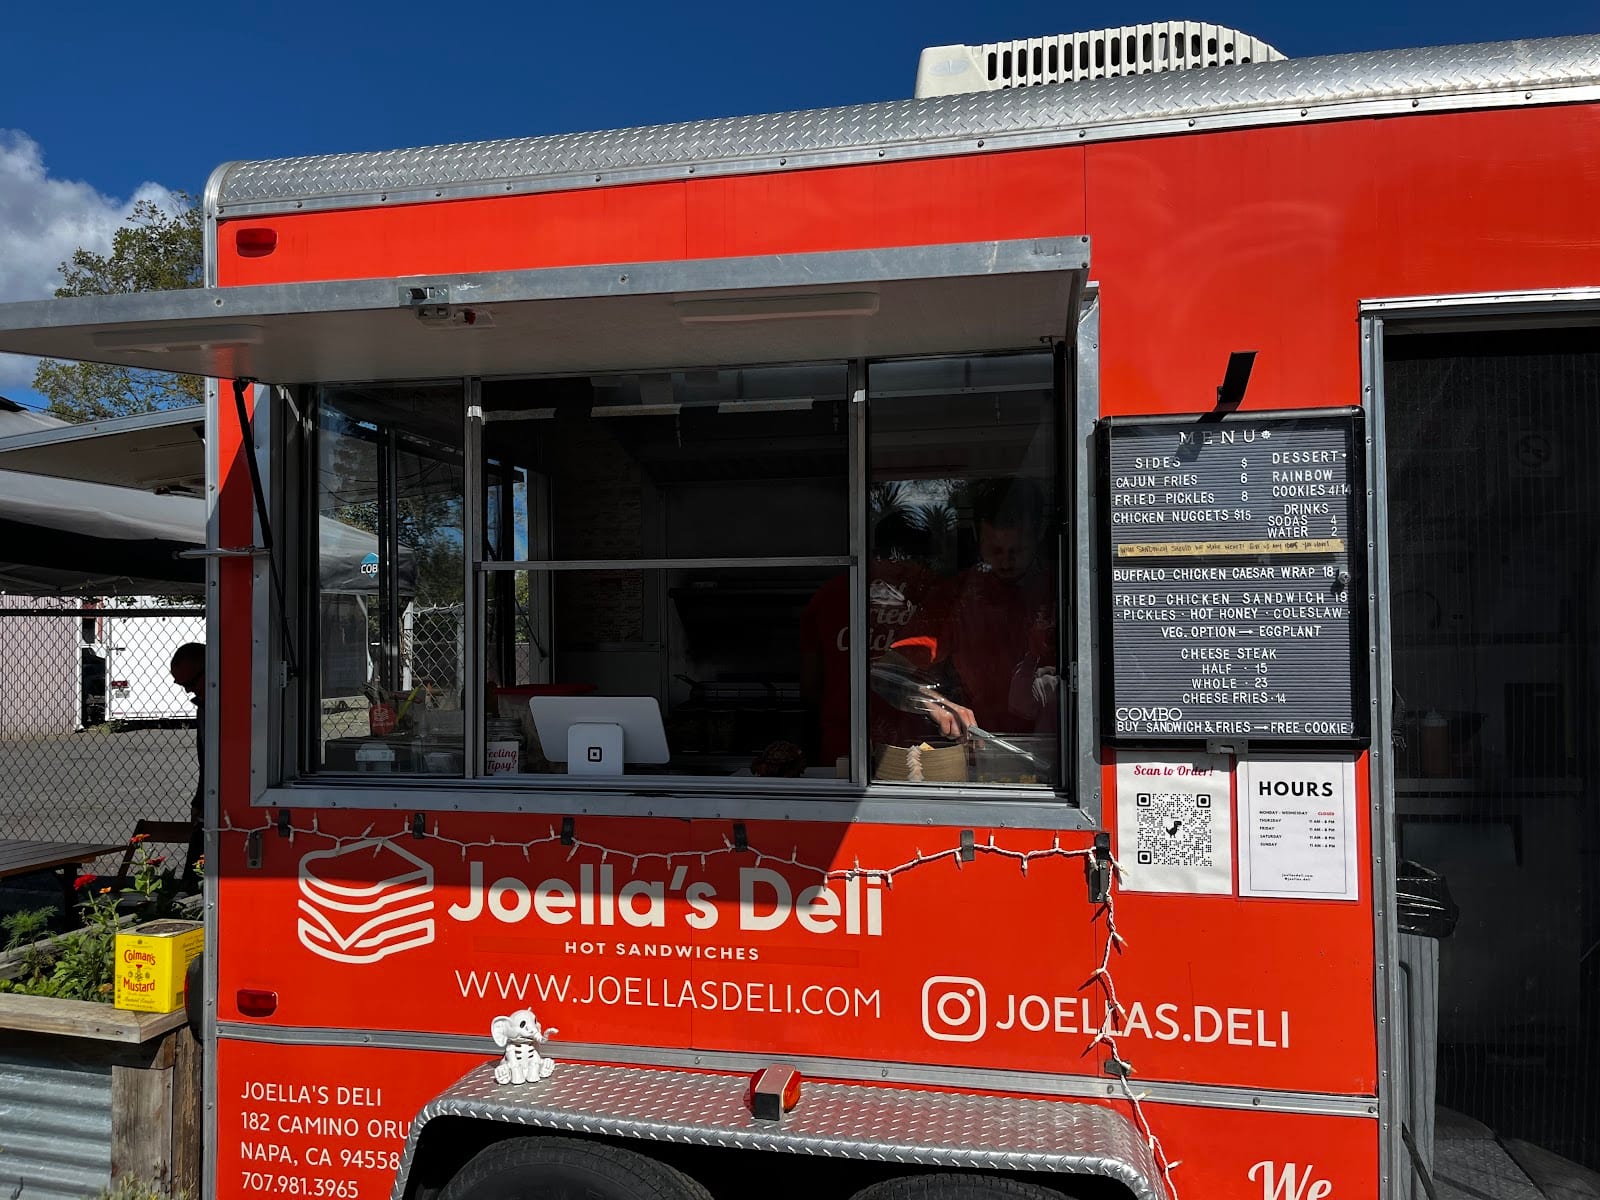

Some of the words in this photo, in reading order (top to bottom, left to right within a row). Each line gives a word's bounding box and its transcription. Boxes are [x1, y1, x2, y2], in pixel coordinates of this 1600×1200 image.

[1179, 430, 1255, 445] MENU
[1135, 457, 1181, 469] SIDES
[1241, 457, 1248, 469] $
[1273, 451, 1338, 464] DESSERT
[1116, 477, 1155, 489] CAJUN
[1164, 475, 1198, 485] FRIES
[1241, 473, 1247, 484] 6
[1273, 469, 1333, 482] RAINBOW
[1273, 484, 1325, 497] COOKIES
[1115, 493, 1155, 506] FRIED
[1166, 492, 1214, 503] PICKLES
[1241, 491, 1248, 502] 8
[1113, 511, 1164, 523] CHICKEN
[1172, 510, 1228, 522] NUGGETS
[1234, 509, 1251, 520] $15
[1284, 503, 1328, 515] DRINKS
[1267, 515, 1307, 526] SODAS
[1330, 515, 1337, 525] 4
[1267, 526, 1308, 538] WATER
[1331, 527, 1337, 537] 2
[1113, 569, 1165, 581] BUFFALO
[1173, 568, 1226, 580] CHICKEN
[1232, 567, 1274, 579] CAESAR
[1281, 567, 1315, 578] WRAP
[1323, 566, 1334, 577] 18
[1115, 595, 1155, 606] FRIED
[1167, 594, 1229, 605] CHICKEN
[1242, 592, 1324, 604] SANDWICH
[1123, 609, 1175, 620] PICKLES
[1190, 609, 1213, 619] HOT
[1219, 608, 1257, 619] HONEY
[1274, 607, 1342, 619] COLESLAW
[1161, 627, 1188, 638] VEG.
[1191, 626, 1236, 637] OPTION
[1259, 625, 1321, 636] EGGPLANT
[1181, 648, 1229, 660] CHEESE
[1237, 648, 1277, 659] STEAK
[1202, 664, 1231, 675] HALF
[1255, 663, 1267, 674] 15
[1191, 678, 1237, 689] WHOLE
[1254, 678, 1267, 688] 23
[1182, 692, 1228, 704] CHEESE
[1232, 692, 1268, 704] FRIES
[1276, 692, 1286, 704] 14
[1115, 707, 1182, 721] COMBO
[1117, 722, 1139, 732] BUY
[1146, 721, 1201, 733] SANDWICH
[1205, 722, 1213, 733] &
[1216, 721, 1250, 733] FRIES
[1270, 722, 1299, 733] FREE
[1305, 722, 1353, 734] COOKIE!
[488, 749, 516, 760] eeling
[1134, 765, 1161, 777] Scan
[1162, 765, 1174, 776] to
[1177, 765, 1215, 777] Order!
[1259, 781, 1333, 797] HOURS
[447, 860, 719, 931] Joella’s
[739, 867, 882, 936] Deli
[124, 949, 155, 965] Colman's
[564, 940, 606, 956] HOT
[615, 944, 760, 961] SANDWICHES
[123, 977, 155, 992] Mustard
[454, 969, 881, 1018] WWW.JOELLASDELI.COM
[996, 994, 1289, 1048] JOELLAS.DELI
[240, 1081, 329, 1104] JOELLA'S
[337, 1087, 381, 1106] DELI
[241, 1112, 270, 1131] 182
[278, 1116, 359, 1137] CAMINO
[241, 1141, 298, 1166] NAPA,
[306, 1148, 332, 1166] CA
[340, 1149, 400, 1170] 94558
[241, 1172, 359, 1198] 707.981.3965
[1248, 1161, 1332, 1200] We
